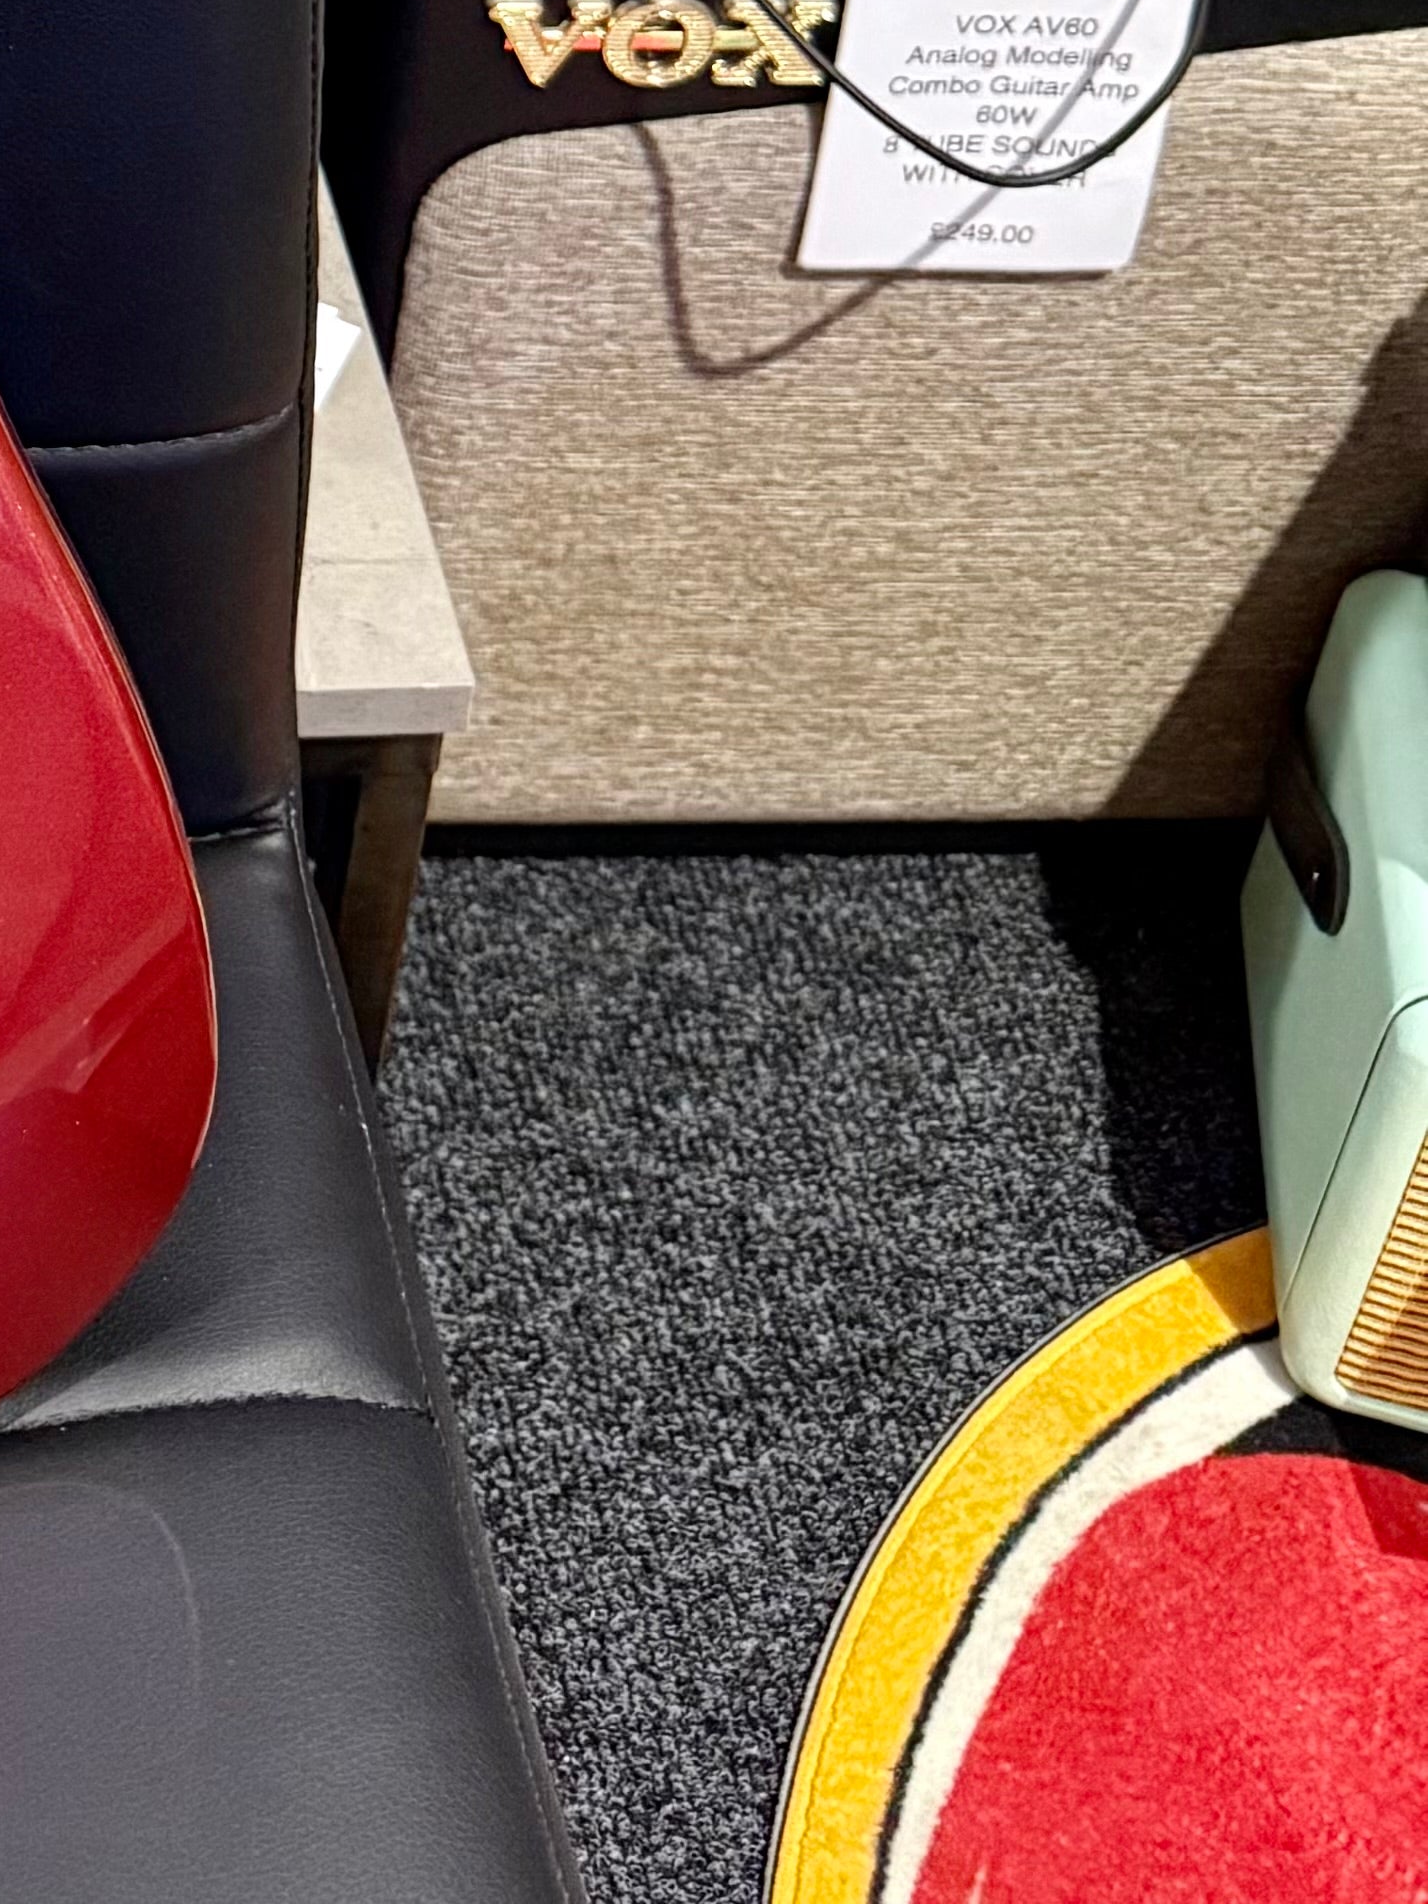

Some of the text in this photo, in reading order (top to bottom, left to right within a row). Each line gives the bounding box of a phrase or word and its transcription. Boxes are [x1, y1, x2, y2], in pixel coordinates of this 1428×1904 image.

[955, 14, 1100, 38] VOX AV60
[905, 45, 1134, 72] Analog Modelling
[887, 74, 1140, 104] Combo Guitar Amp
[975, 104, 1039, 126] 60W
[990, 134, 1118, 158] SOUND
